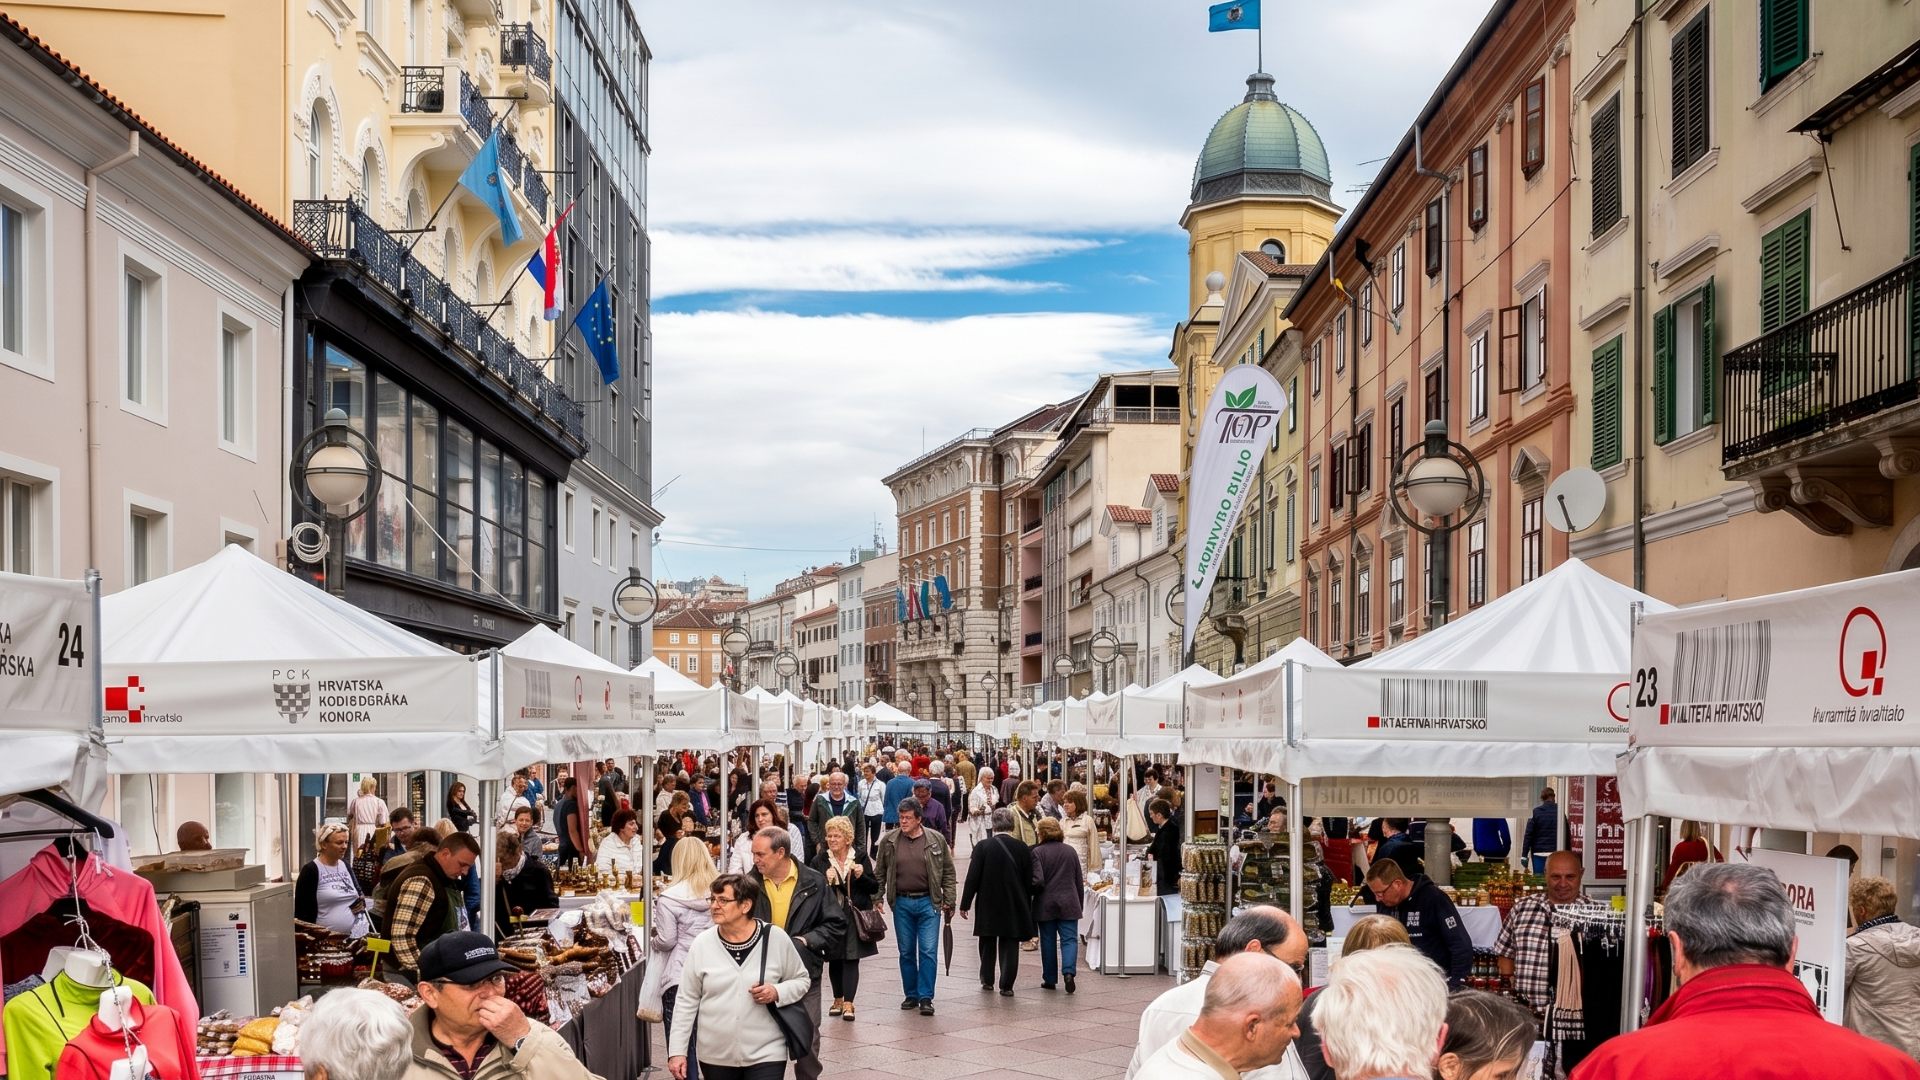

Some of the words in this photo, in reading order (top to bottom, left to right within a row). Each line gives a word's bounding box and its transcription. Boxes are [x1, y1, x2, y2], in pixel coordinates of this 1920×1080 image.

[58, 622, 84, 668] 24
[318, 679, 383, 691] HRVATSKA
[1635, 667, 1658, 708] 23
[320, 711, 371, 722] KONORA
